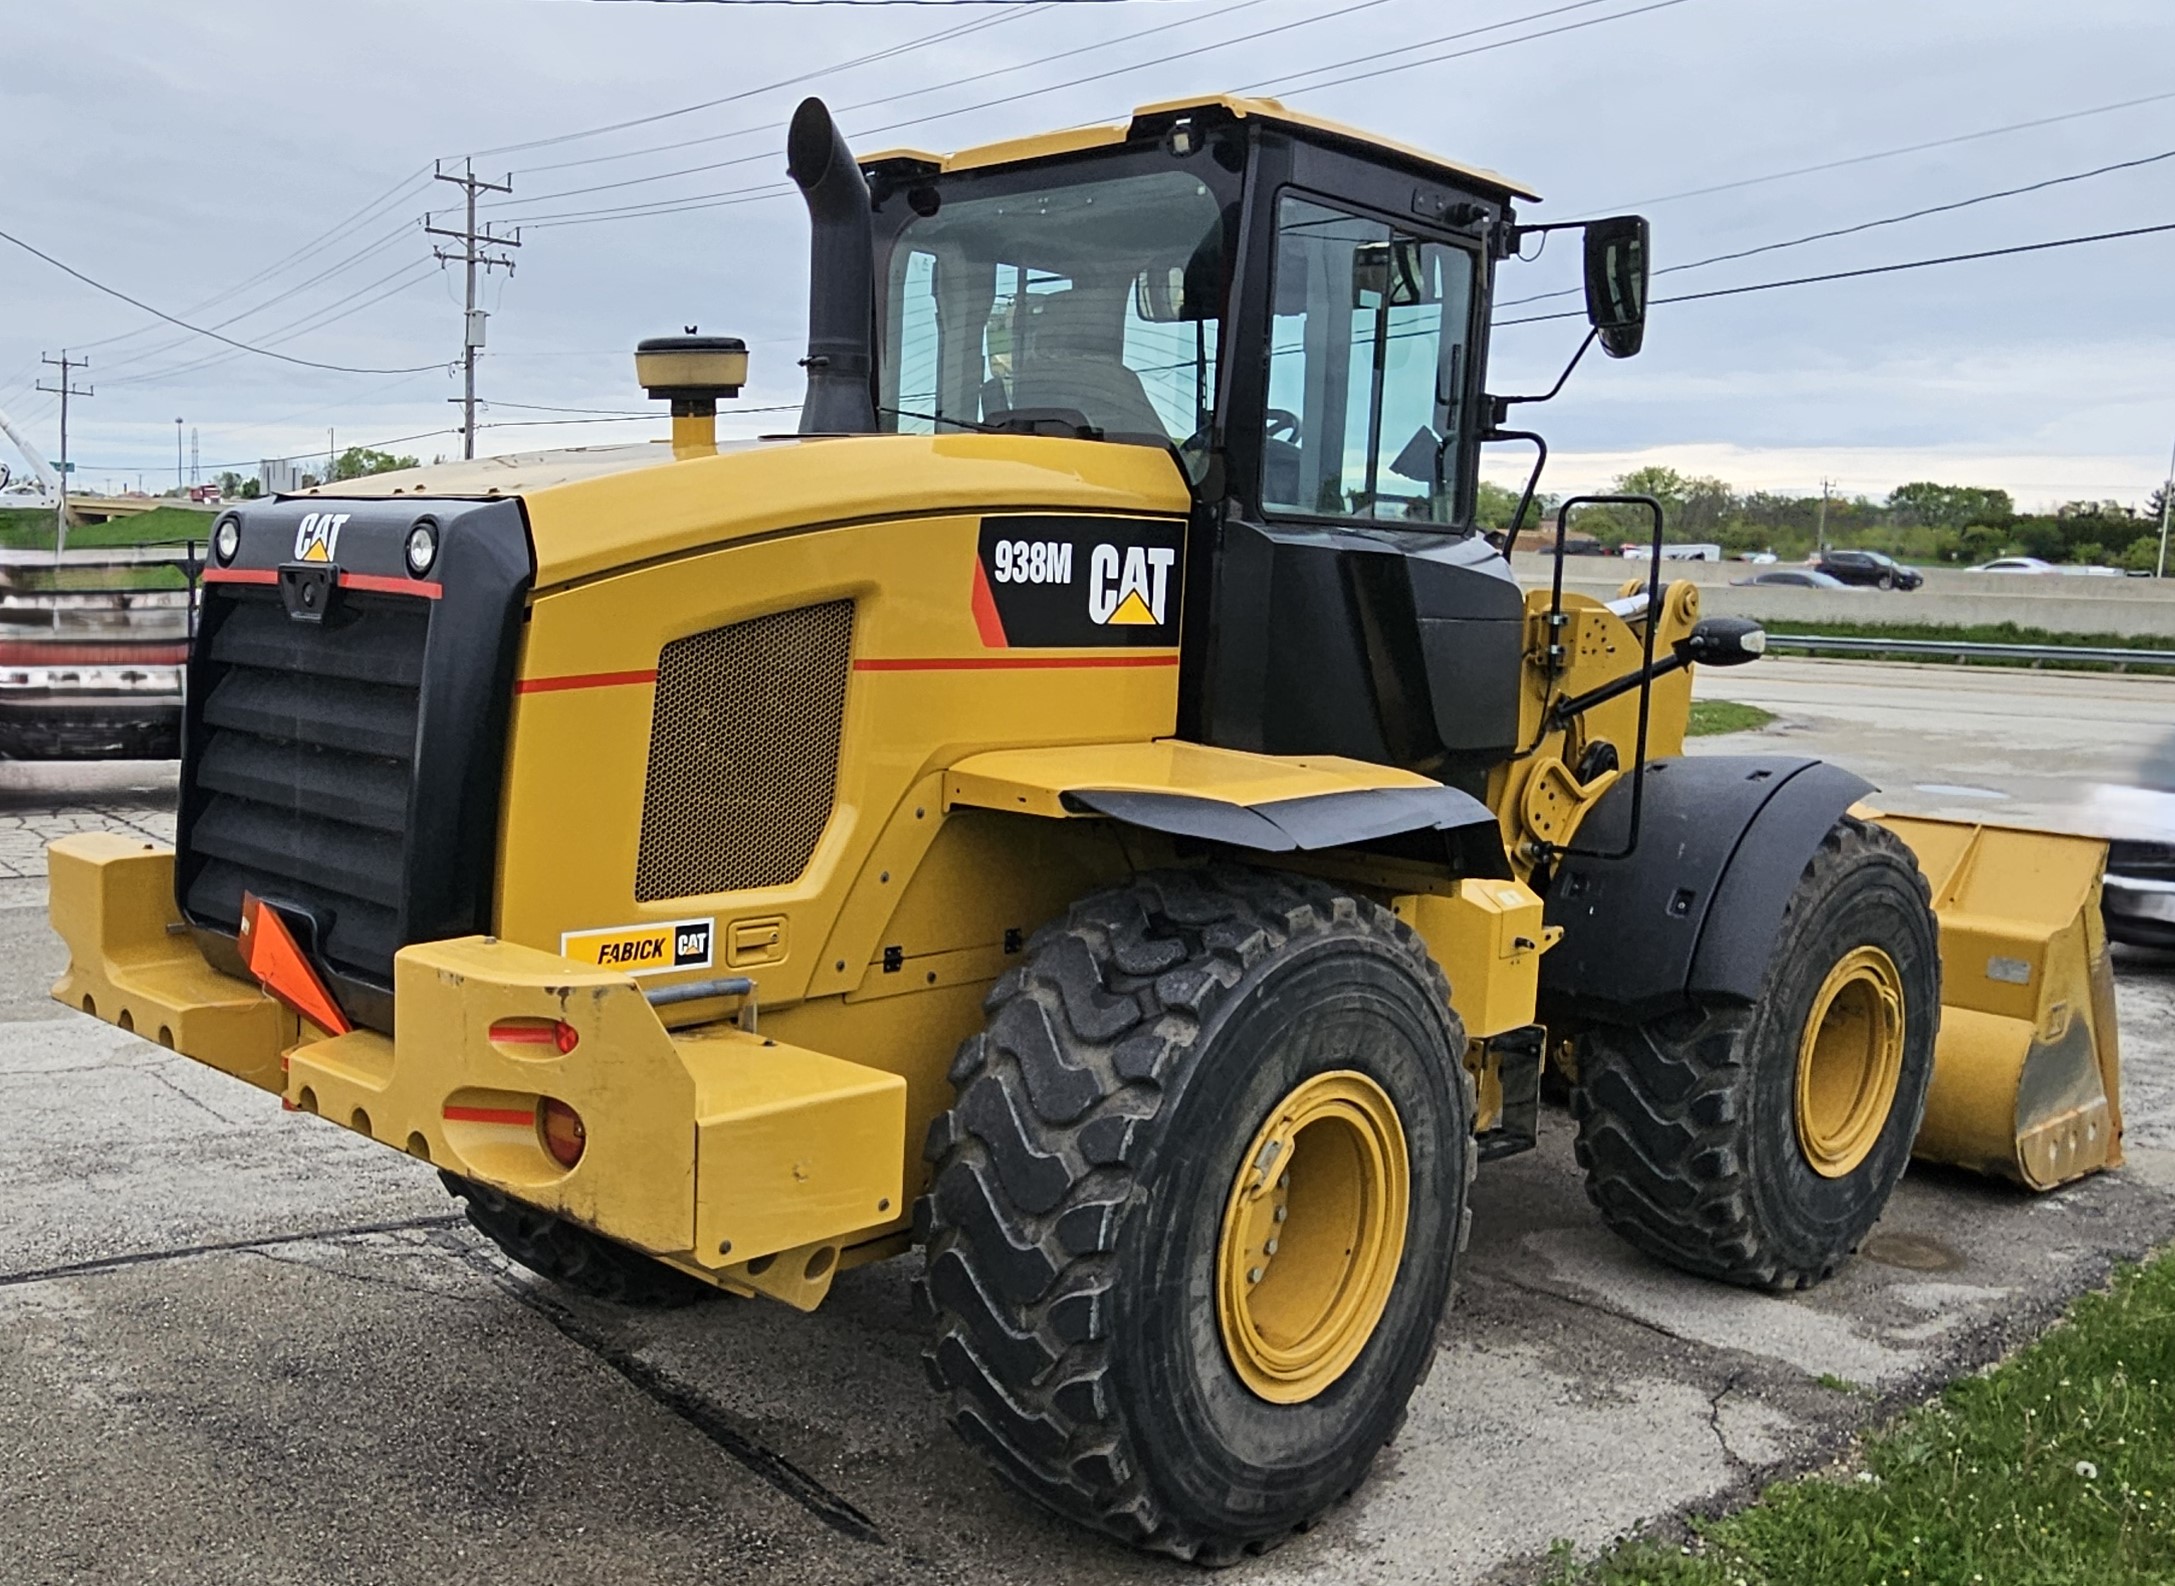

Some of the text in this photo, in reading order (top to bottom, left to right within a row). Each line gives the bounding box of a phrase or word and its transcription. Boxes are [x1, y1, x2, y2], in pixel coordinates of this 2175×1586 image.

[294, 513, 351, 562] CAT
[994, 539, 1175, 626] 938M CAT
[597, 932, 708, 965] FABICK CAT
